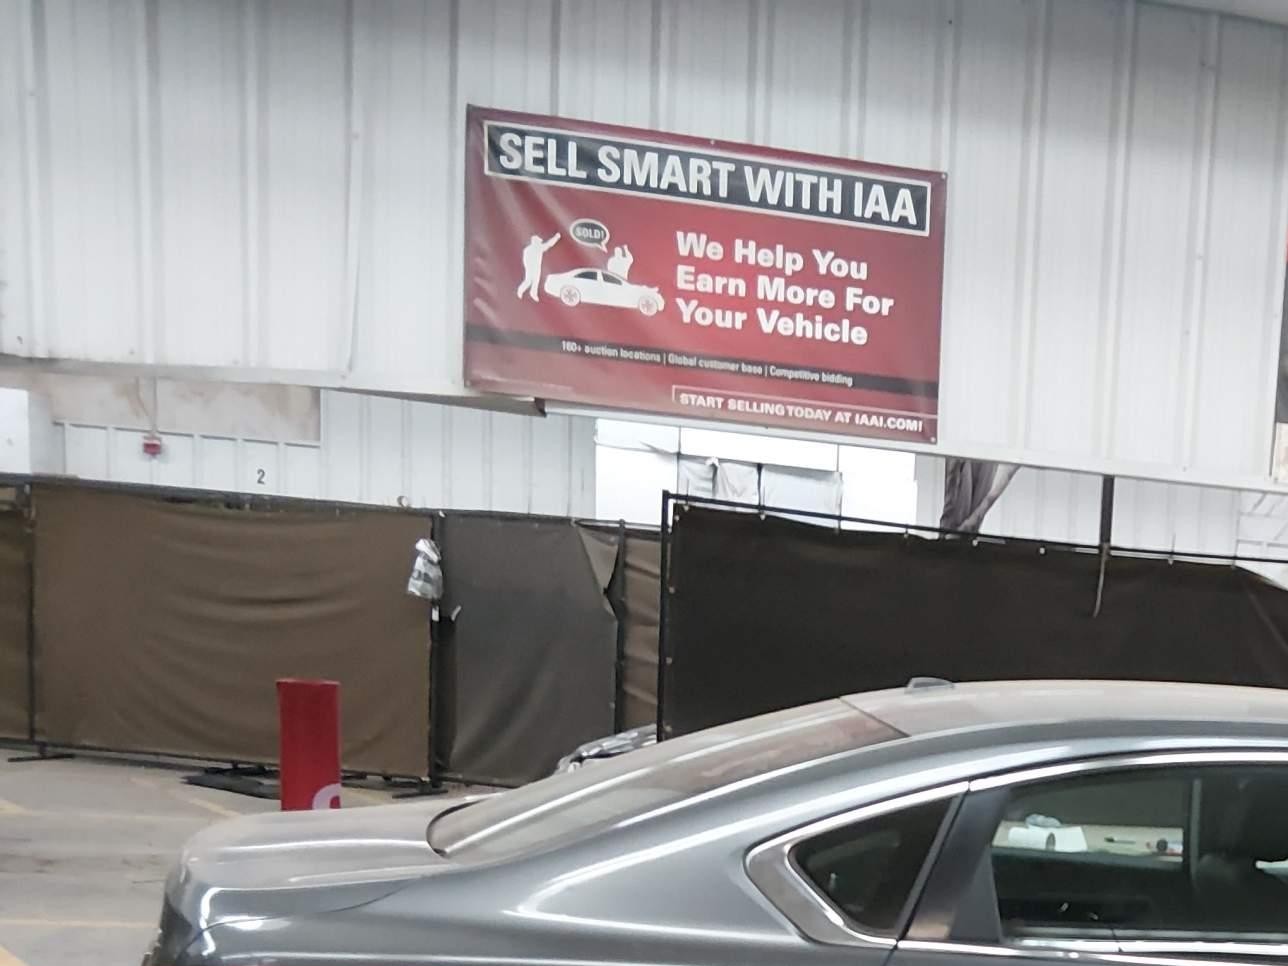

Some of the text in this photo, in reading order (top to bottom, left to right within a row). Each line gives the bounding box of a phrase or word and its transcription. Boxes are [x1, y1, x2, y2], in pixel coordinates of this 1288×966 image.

[499, 133, 917, 225] SELL SMART WITH IAA
[573, 226, 605, 240] SOLD!
[676, 231, 868, 280] We Help You
[676, 264, 894, 316] Earn More For
[675, 298, 868, 345] Your Vehicle
[584, 345, 619, 358] auction
[620, 348, 661, 363] locations
[668, 353, 697, 367] Global
[698, 359, 739, 371] customer
[741, 362, 762, 375] base
[769, 366, 819, 381] Competitive
[821, 372, 853, 388] bidding
[680, 393, 923, 432] START SELLING TODAY AT IAAI.COM!
[256, 468, 266, 485] 2
